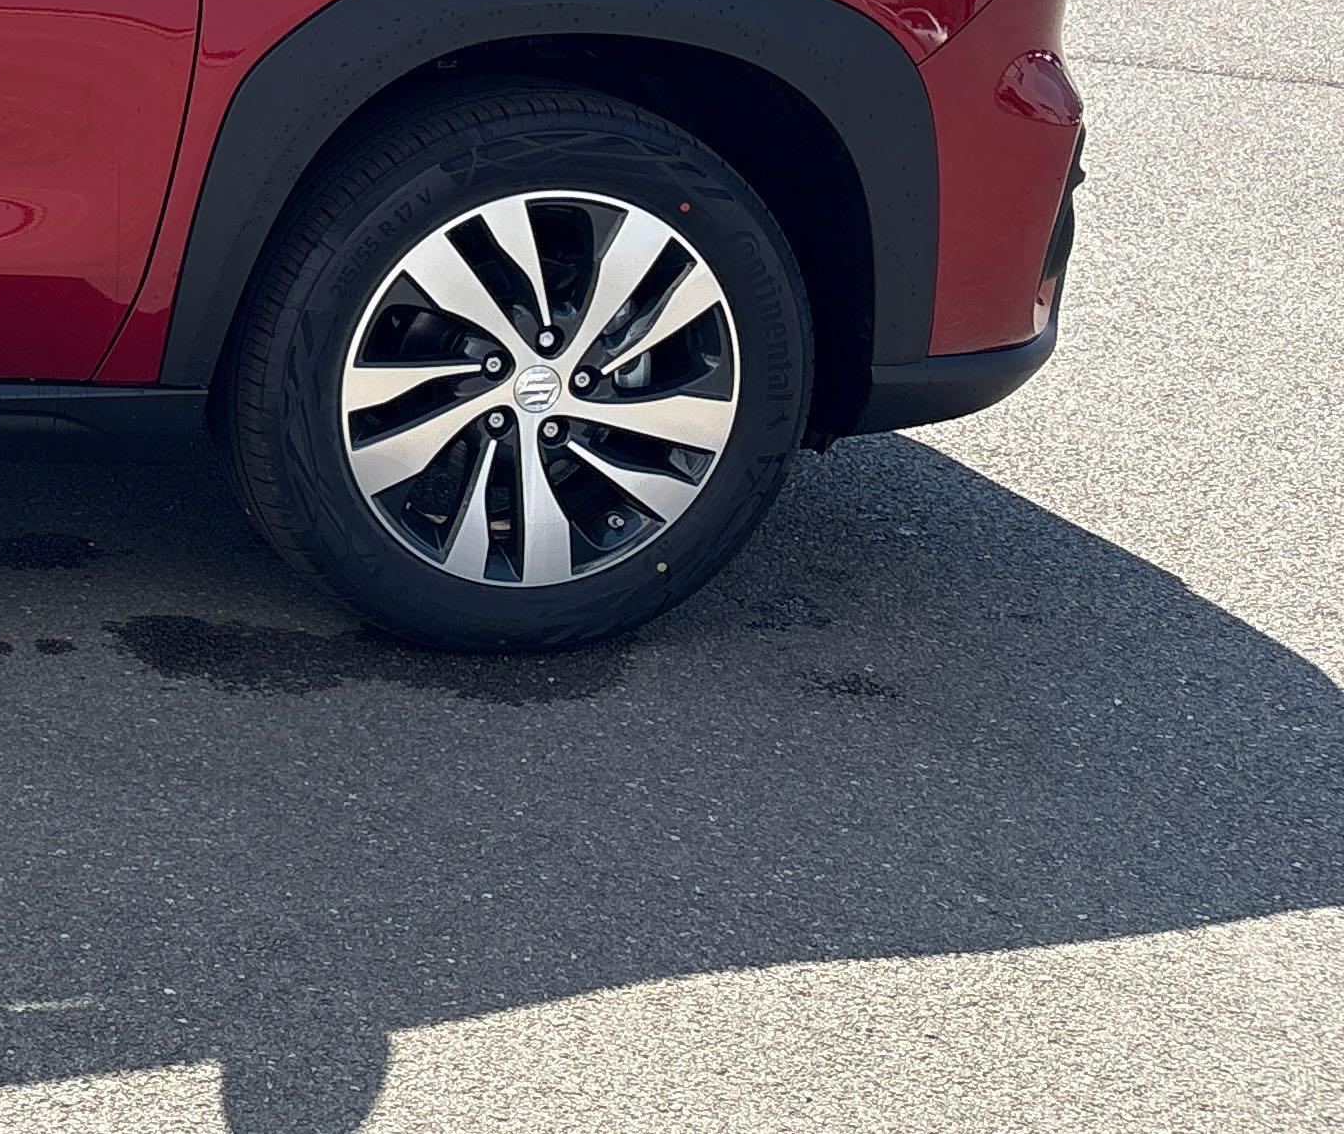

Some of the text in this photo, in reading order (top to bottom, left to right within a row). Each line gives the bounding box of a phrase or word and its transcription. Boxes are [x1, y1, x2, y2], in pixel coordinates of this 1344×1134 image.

[330, 186, 432, 298] 215/55 R 17 V
[730, 230, 794, 402] Continental
